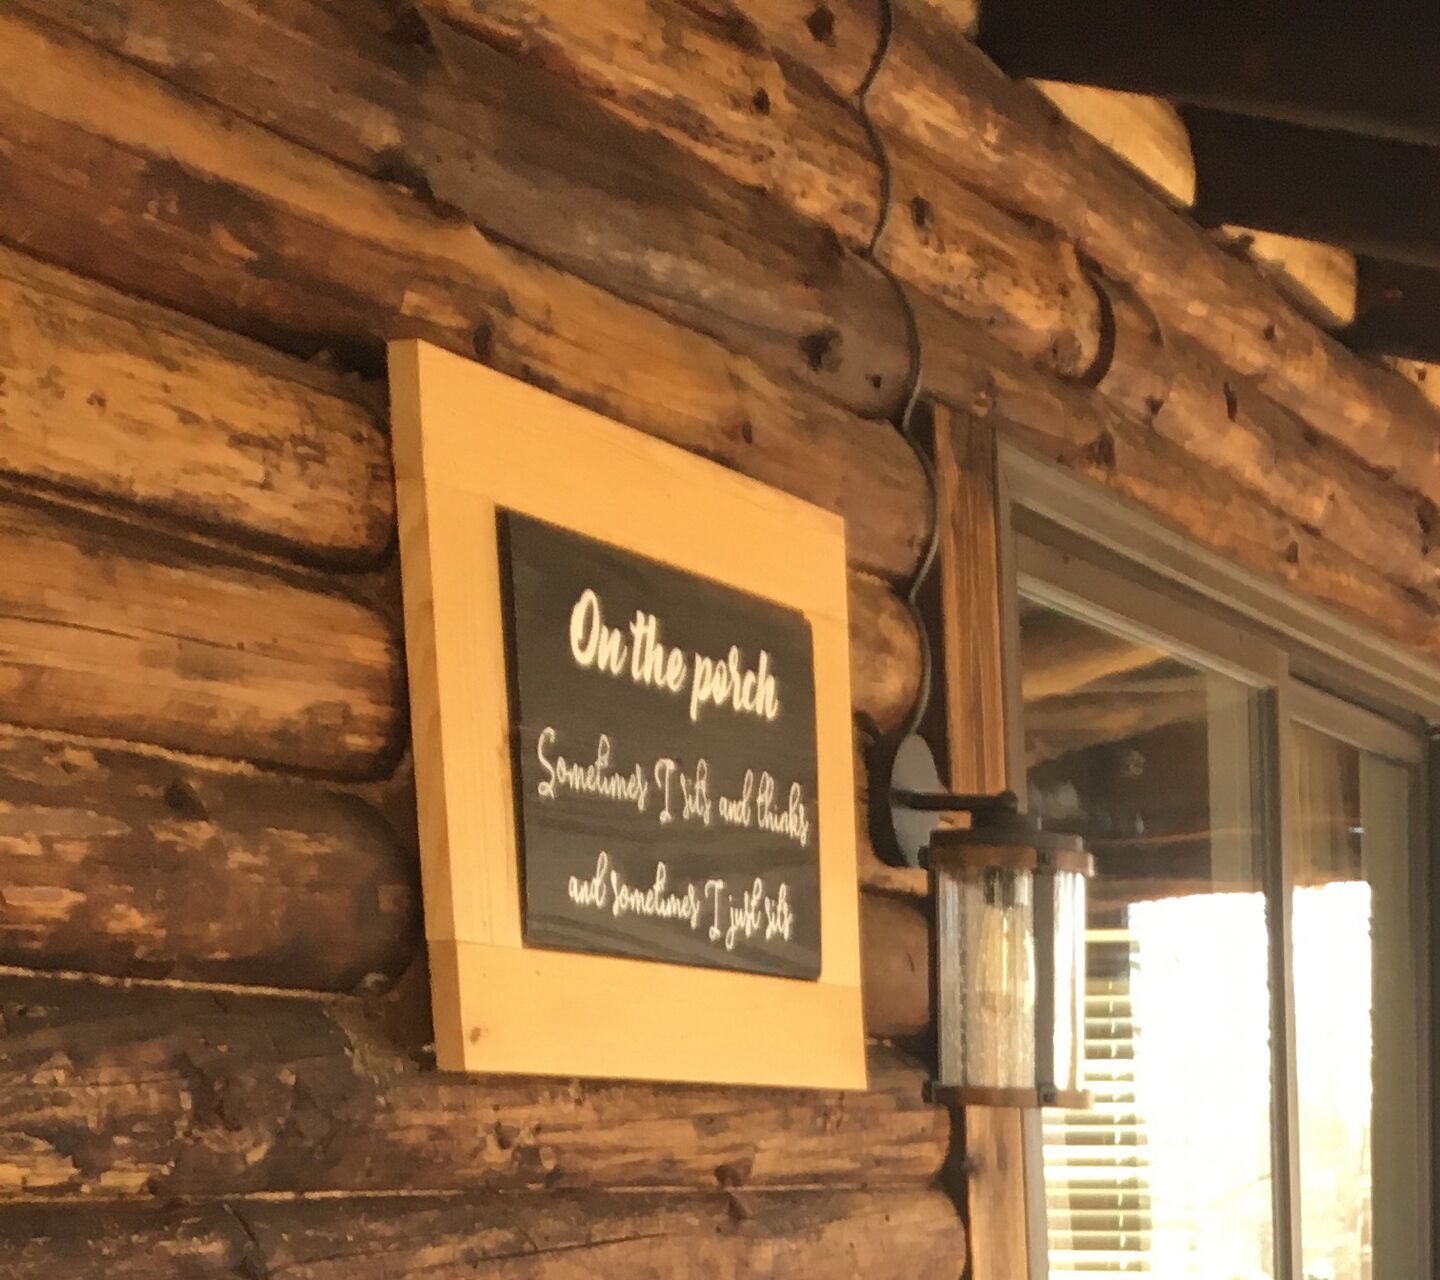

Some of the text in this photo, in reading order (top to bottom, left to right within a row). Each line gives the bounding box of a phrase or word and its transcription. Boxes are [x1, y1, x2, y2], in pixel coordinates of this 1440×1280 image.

[569, 588, 778, 722] On the porch
[537, 726, 808, 847] Sometimes I sits and thinks
[568, 850, 793, 951] and sometimes I just sits
